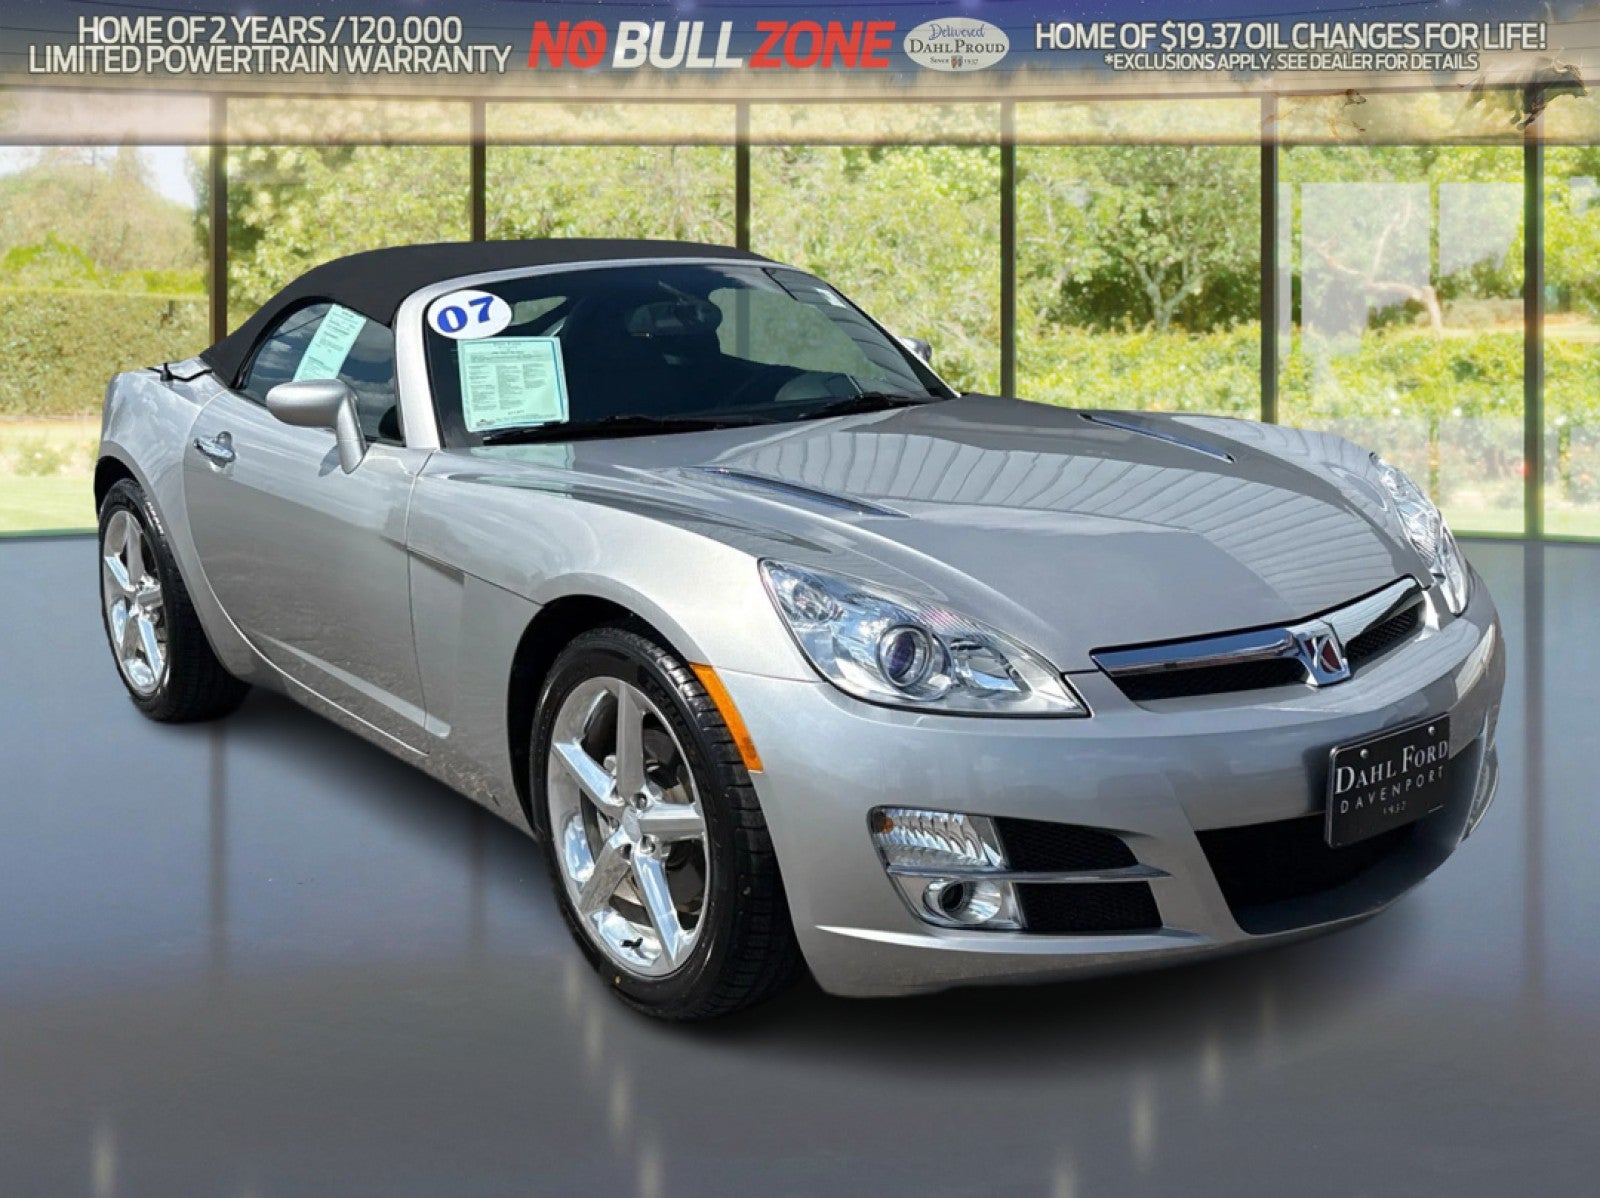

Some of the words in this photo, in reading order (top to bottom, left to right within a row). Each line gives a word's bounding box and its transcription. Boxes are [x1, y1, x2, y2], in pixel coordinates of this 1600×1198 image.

[437, 296, 494, 333] 07
[1335, 760, 1397, 795] DAHL
[1402, 741, 1448, 774] FORD
[1340, 766, 1444, 814] DAVENPORT
